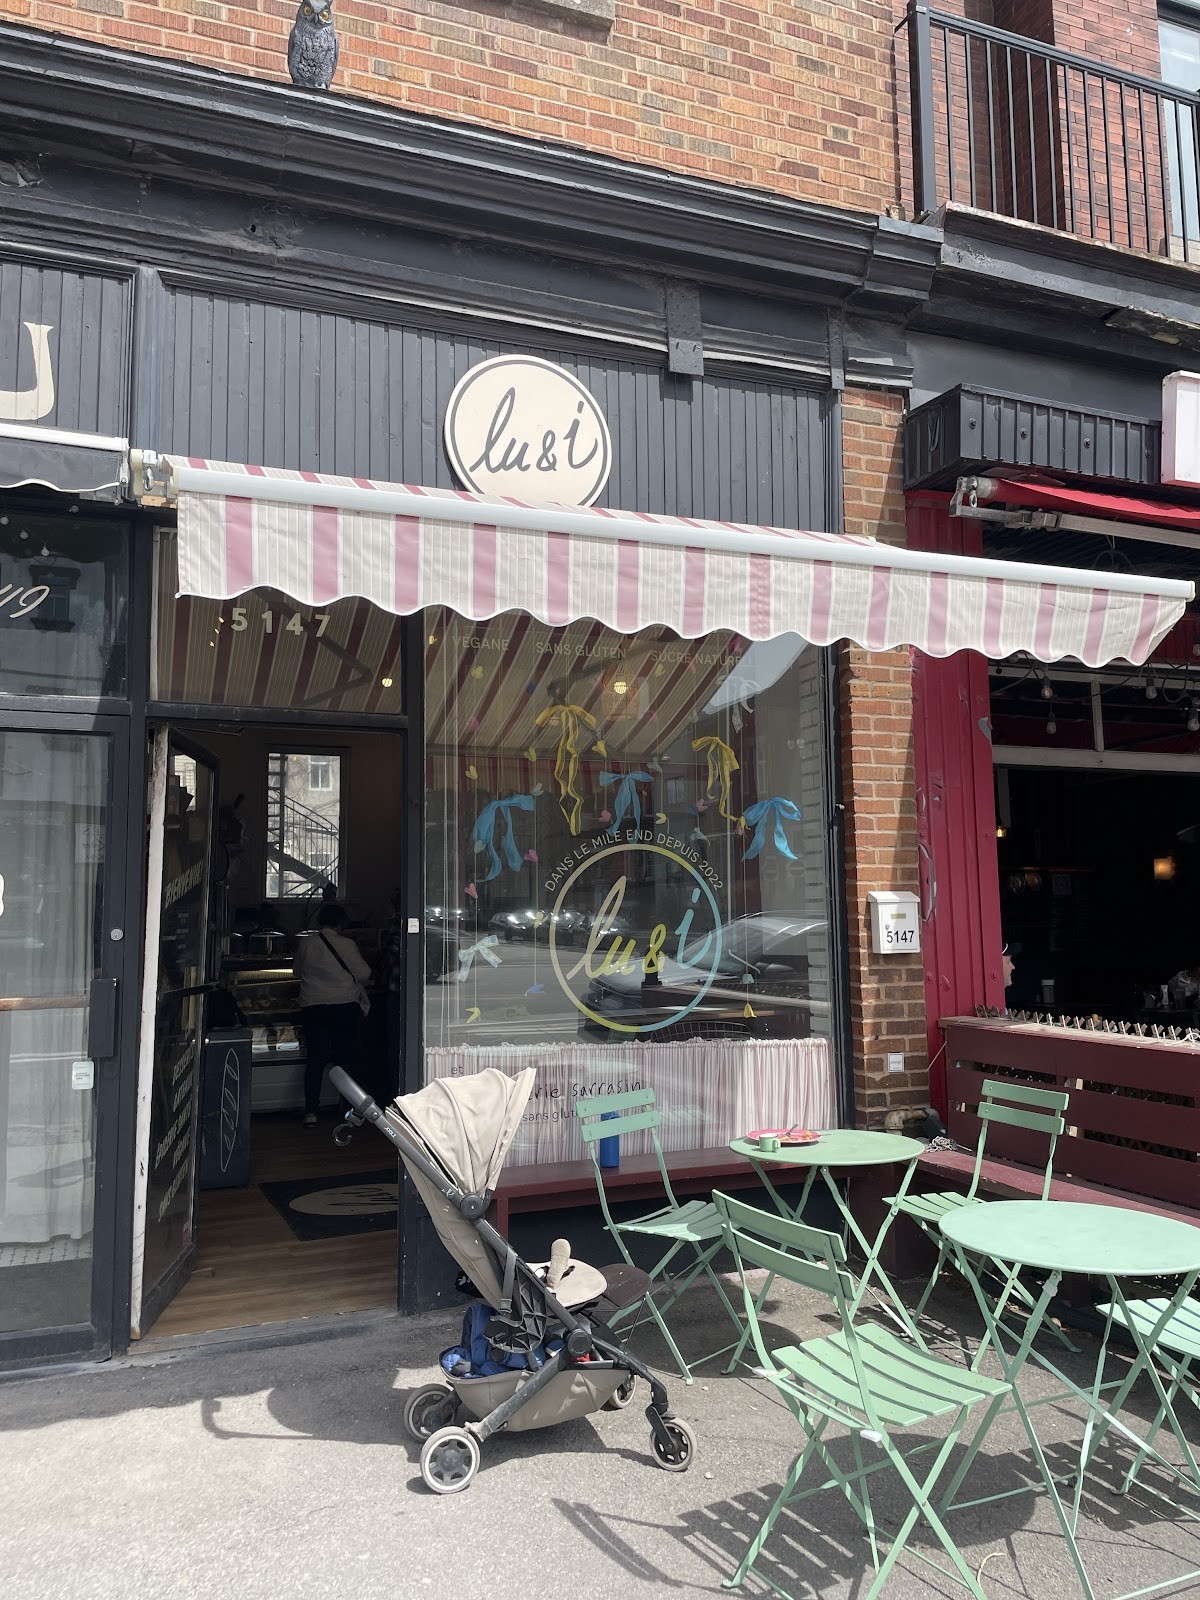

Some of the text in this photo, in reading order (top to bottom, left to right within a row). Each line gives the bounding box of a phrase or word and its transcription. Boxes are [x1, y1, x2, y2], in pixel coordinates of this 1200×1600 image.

[231, 607, 330, 637] 5147
[453, 634, 509, 651] VÉGANE
[536, 641, 626, 659] SANS GLUTEN
[544, 829, 724, 892] DANS LE MILE END DEPUIS 2022
[886, 930, 915, 944] 5147
[572, 1079, 641, 1097] sarrasin
[522, 1107, 578, 1123] sans glut
